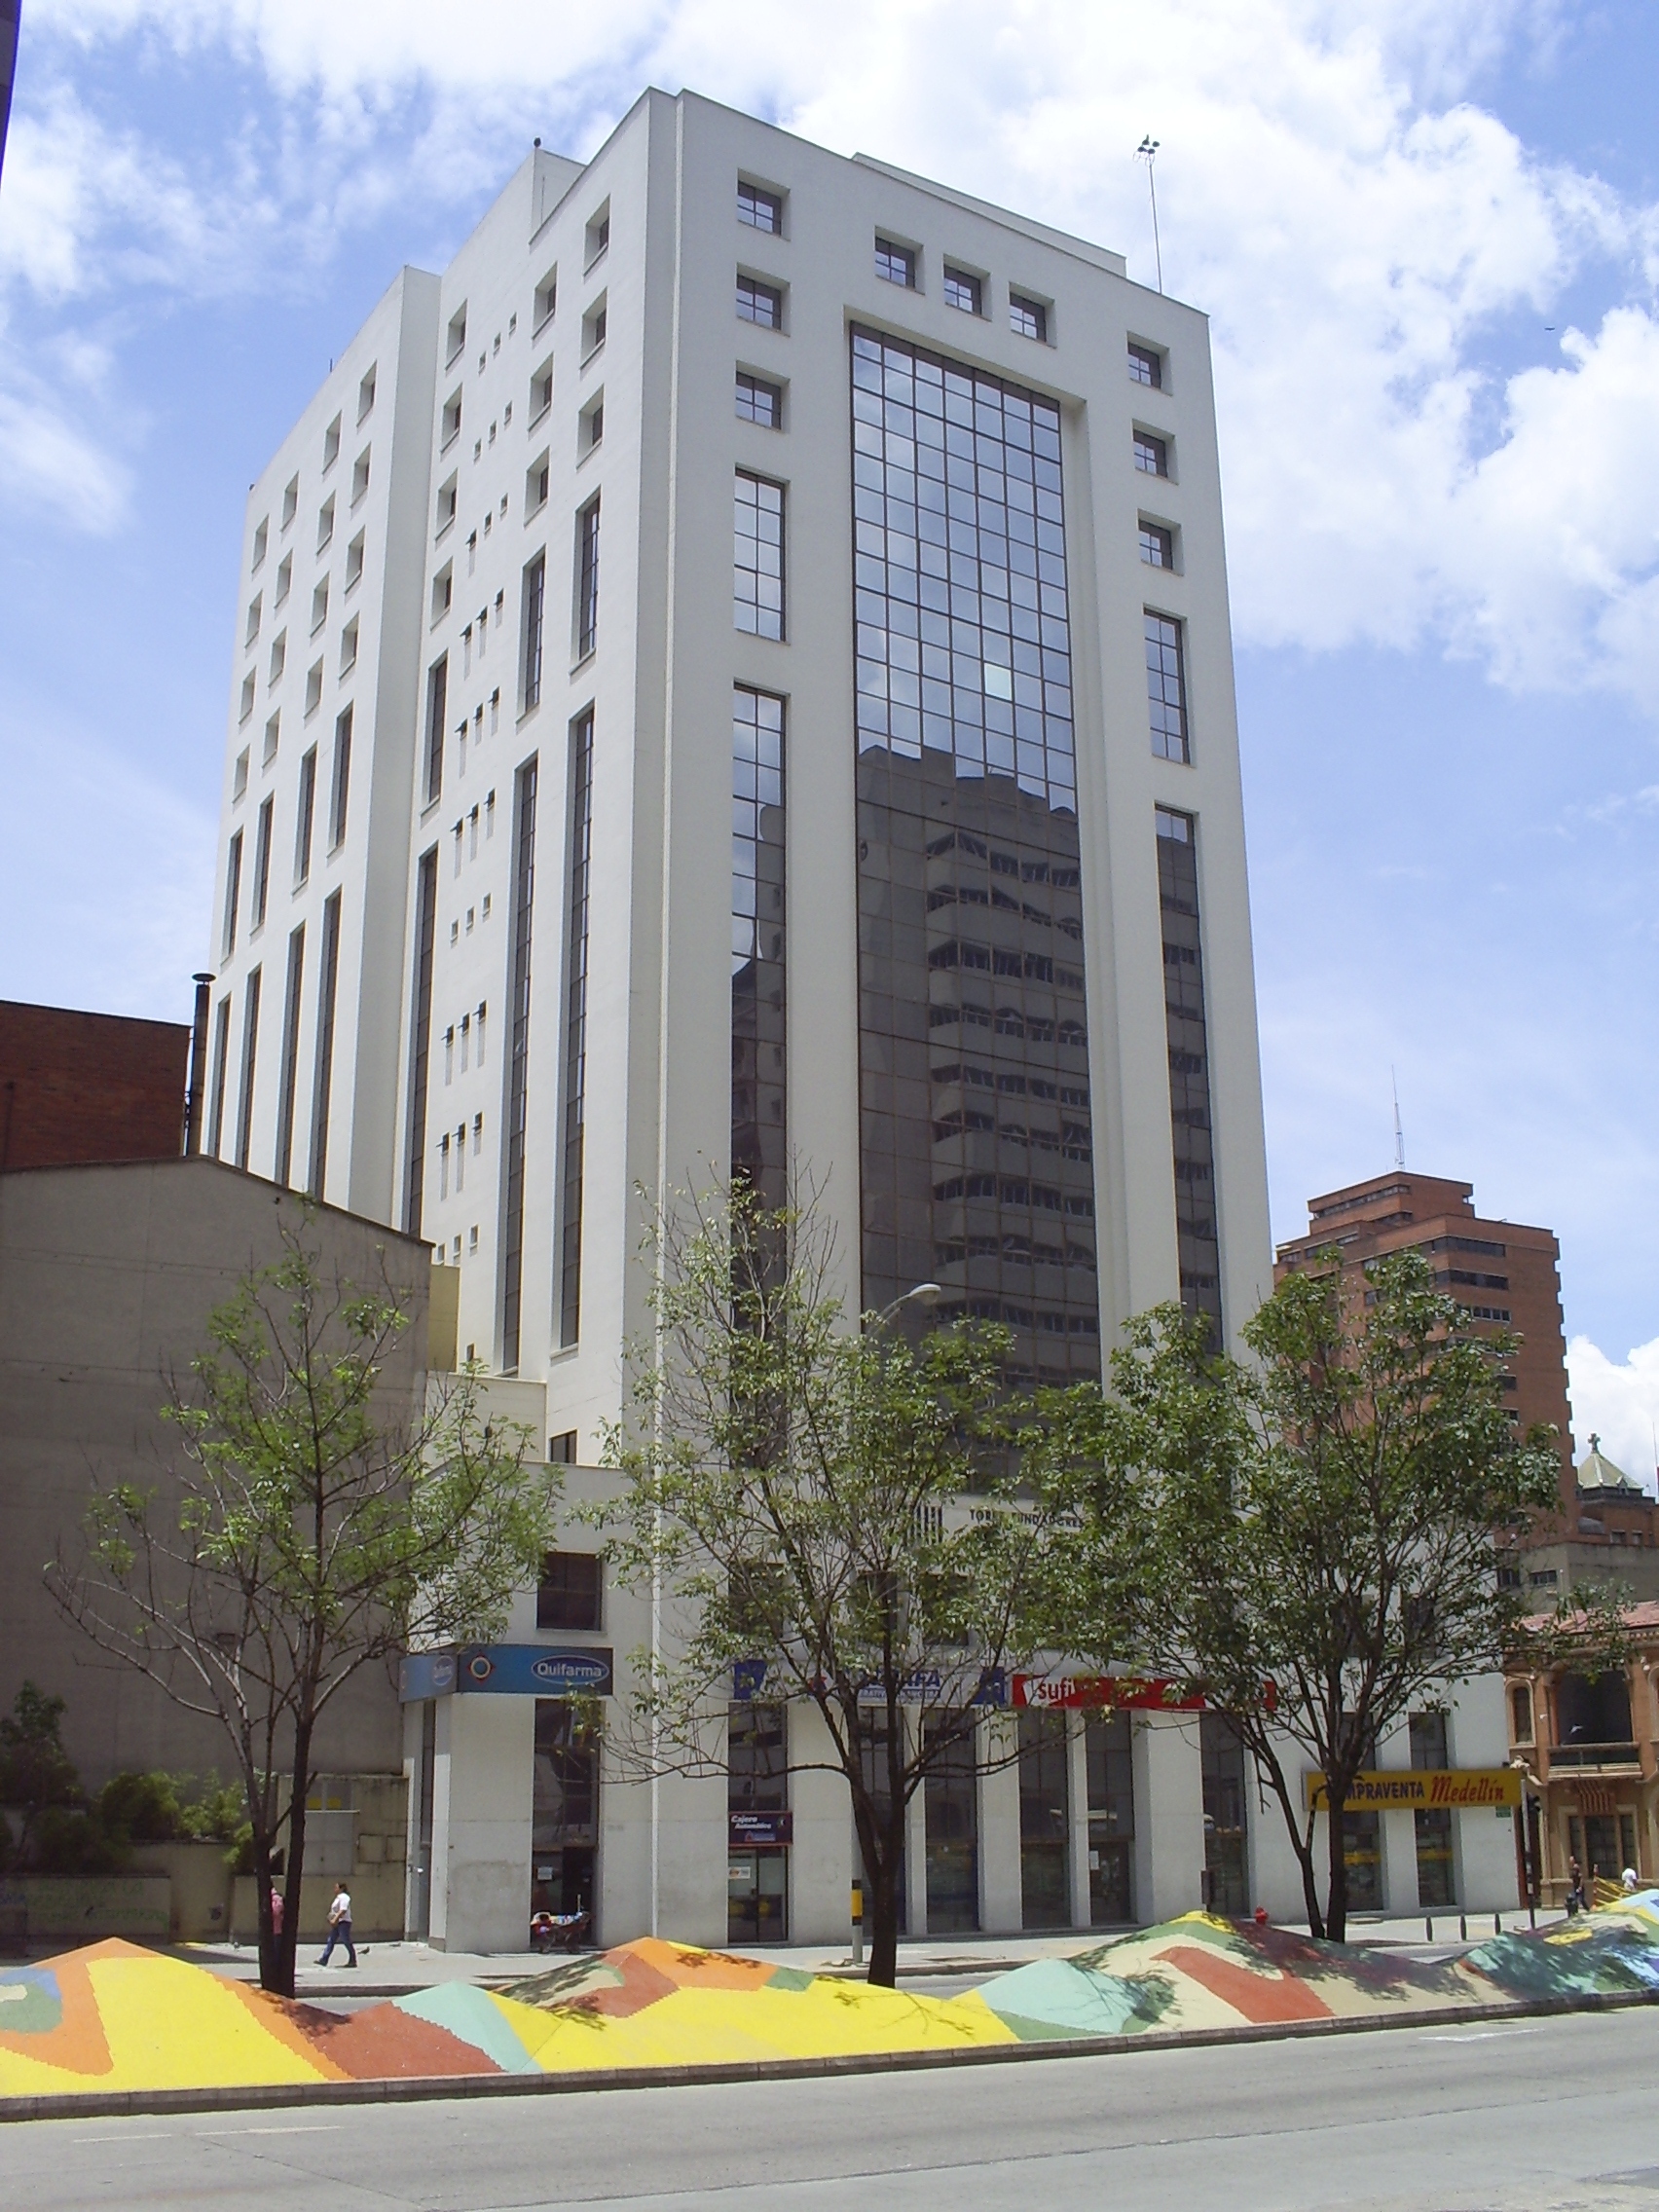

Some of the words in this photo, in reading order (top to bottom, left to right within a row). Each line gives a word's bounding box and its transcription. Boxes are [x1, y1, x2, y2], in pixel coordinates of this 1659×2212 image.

[970, 1509, 1004, 1523] TOR
[536, 1662, 602, 1677] Quifarma
[1328, 1781, 1424, 1800] MPRAVENTA
[1430, 1775, 1504, 1802] Medellín
